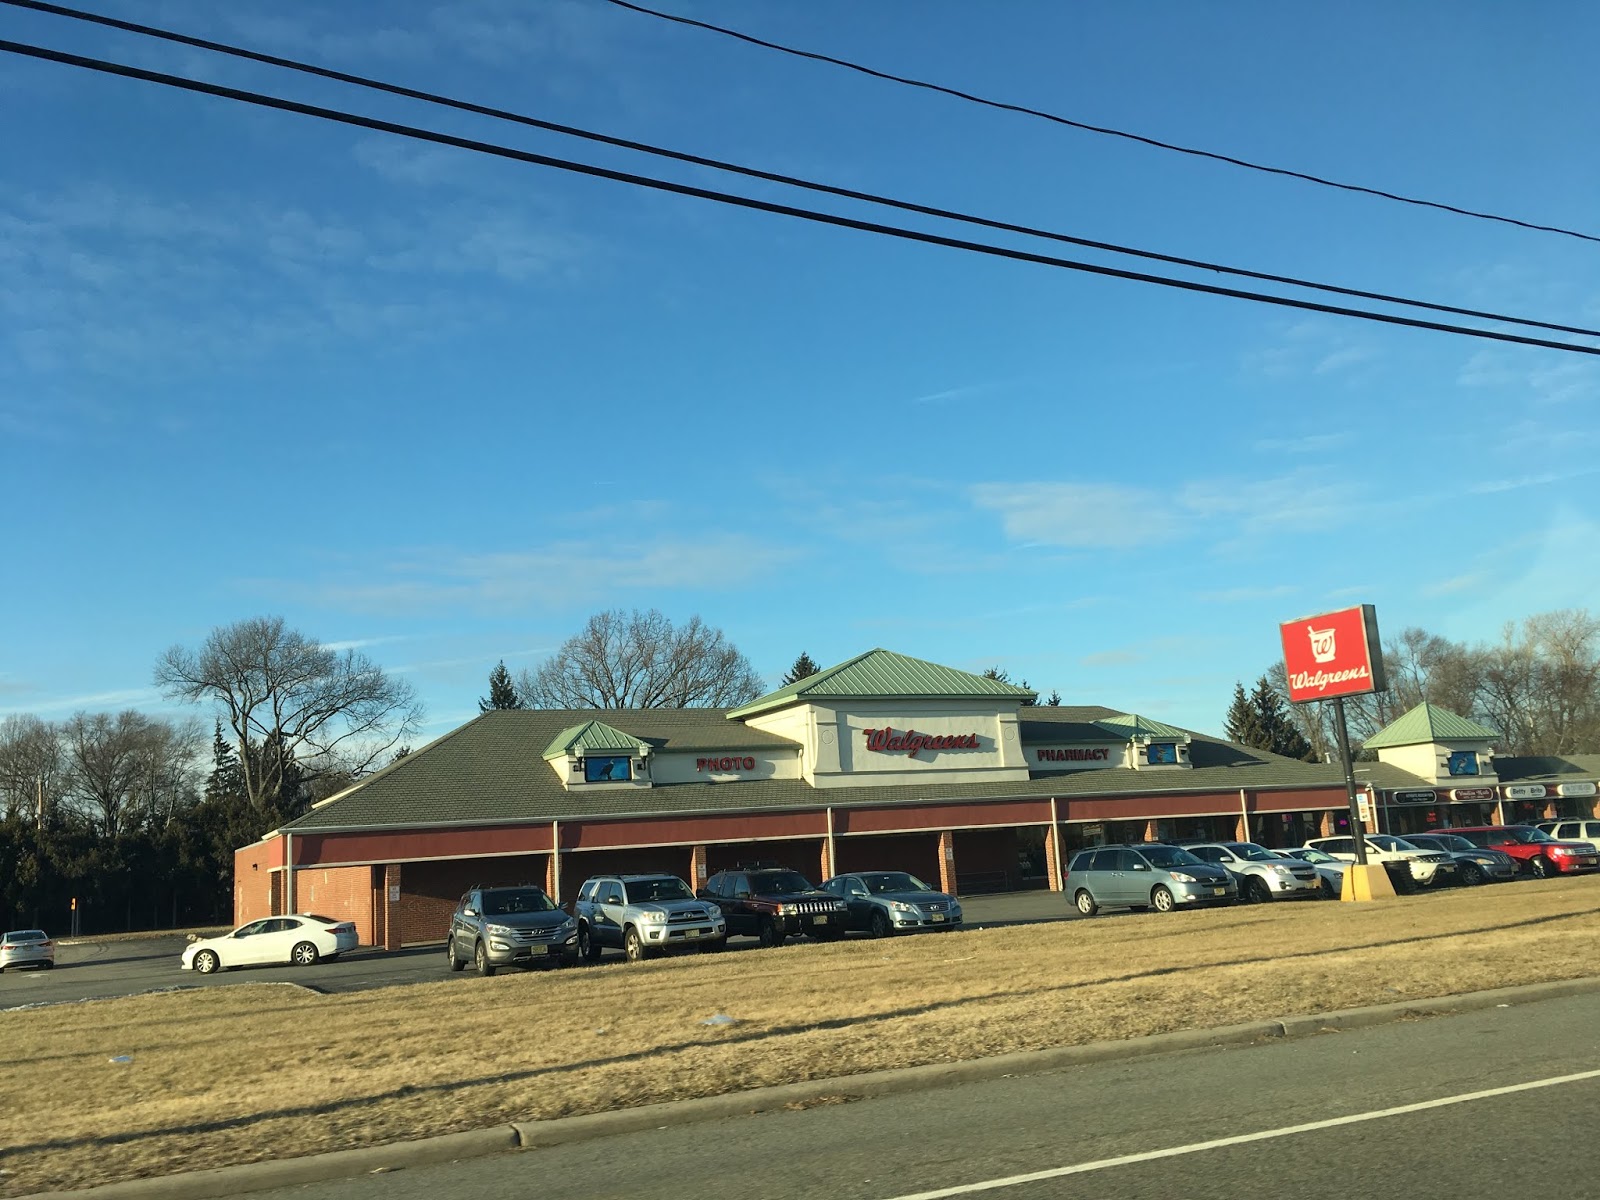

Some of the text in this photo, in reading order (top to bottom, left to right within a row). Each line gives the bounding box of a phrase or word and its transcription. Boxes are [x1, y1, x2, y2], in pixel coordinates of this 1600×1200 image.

[1313, 635, 1333, 655] W
[1289, 665, 1369, 691] Walgreens
[862, 726, 980, 758] Walgreens
[696, 756, 755, 772] PHOTO
[1037, 748, 1109, 761] PHARMACY
